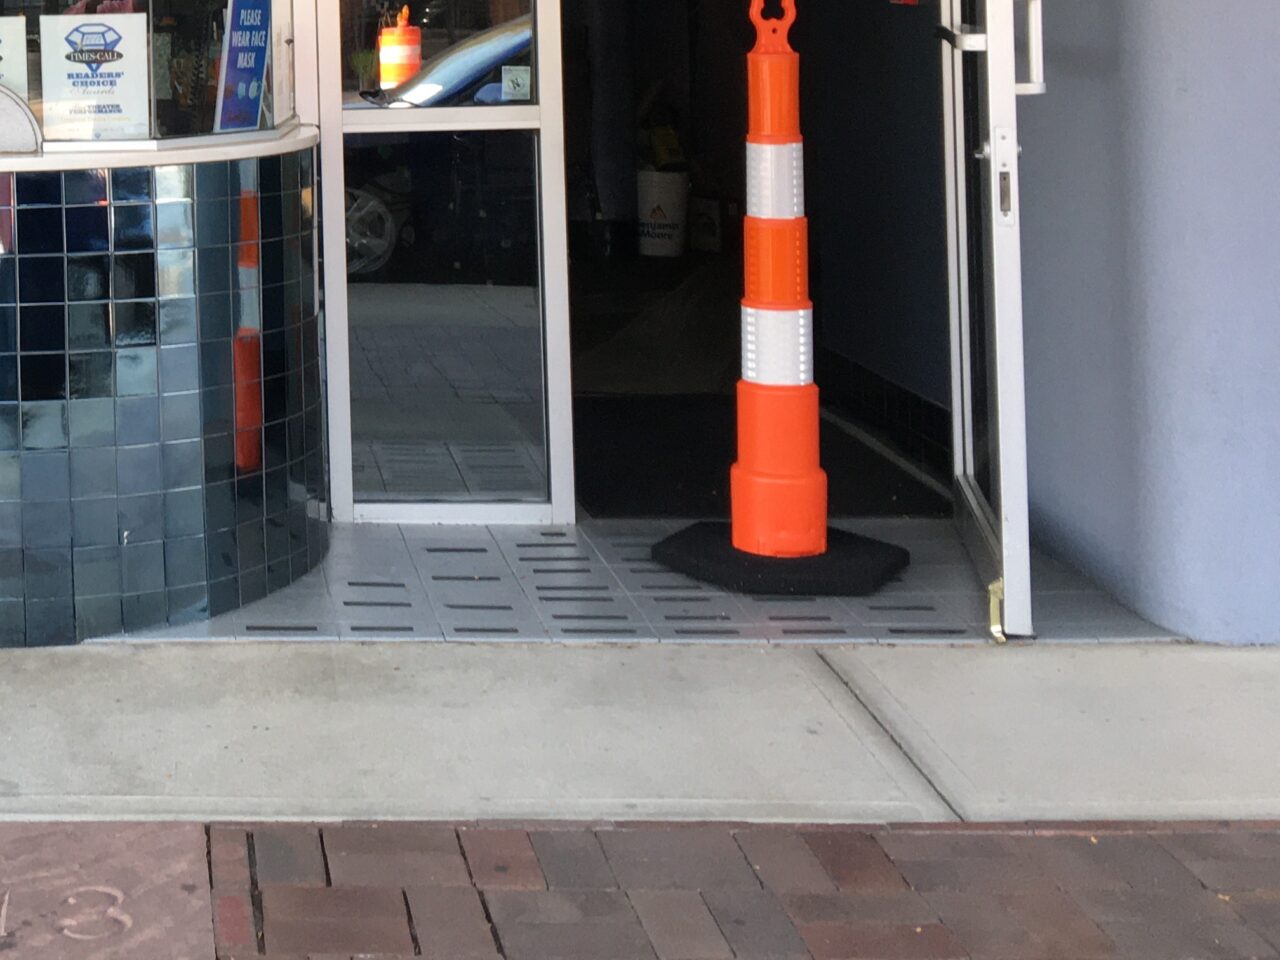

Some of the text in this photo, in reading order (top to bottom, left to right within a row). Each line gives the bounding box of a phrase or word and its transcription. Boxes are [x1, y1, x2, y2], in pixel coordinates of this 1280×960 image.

[239, 9, 262, 26] PLEASE
[232, 30, 266, 47] WEAR FACE
[70, 52, 119, 61] TIMES-CALL
[236, 52, 256, 69] MASK
[67, 72, 124, 80] READERS'
[640, 222, 680, 231] enjamin
